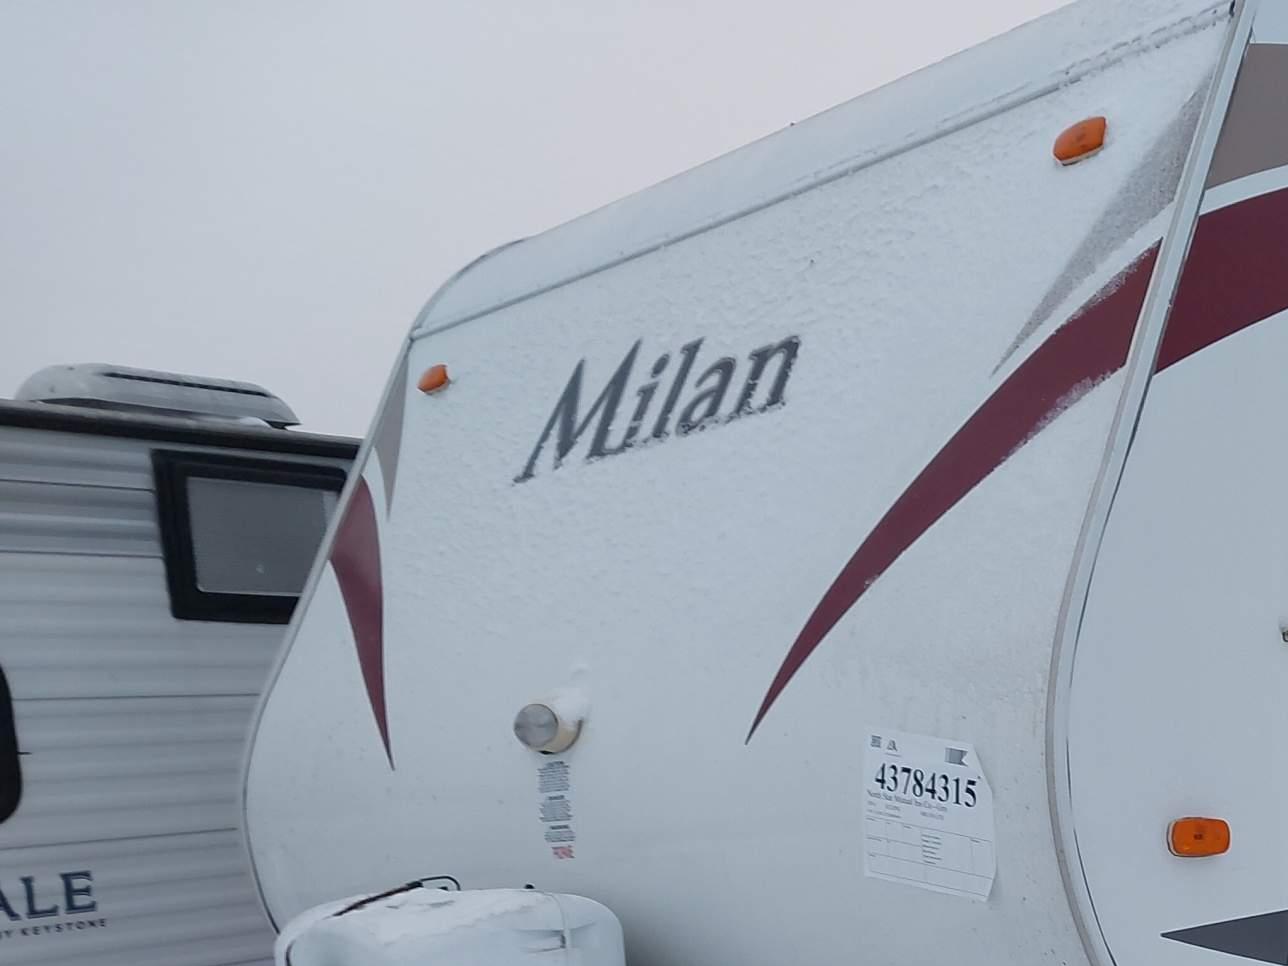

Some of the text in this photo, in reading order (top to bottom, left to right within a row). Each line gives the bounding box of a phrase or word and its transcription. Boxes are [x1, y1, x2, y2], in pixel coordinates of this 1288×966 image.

[512, 335, 800, 484] Milan
[875, 763, 977, 808] 43784315
[21, 918, 107, 936] KEYSTONE
